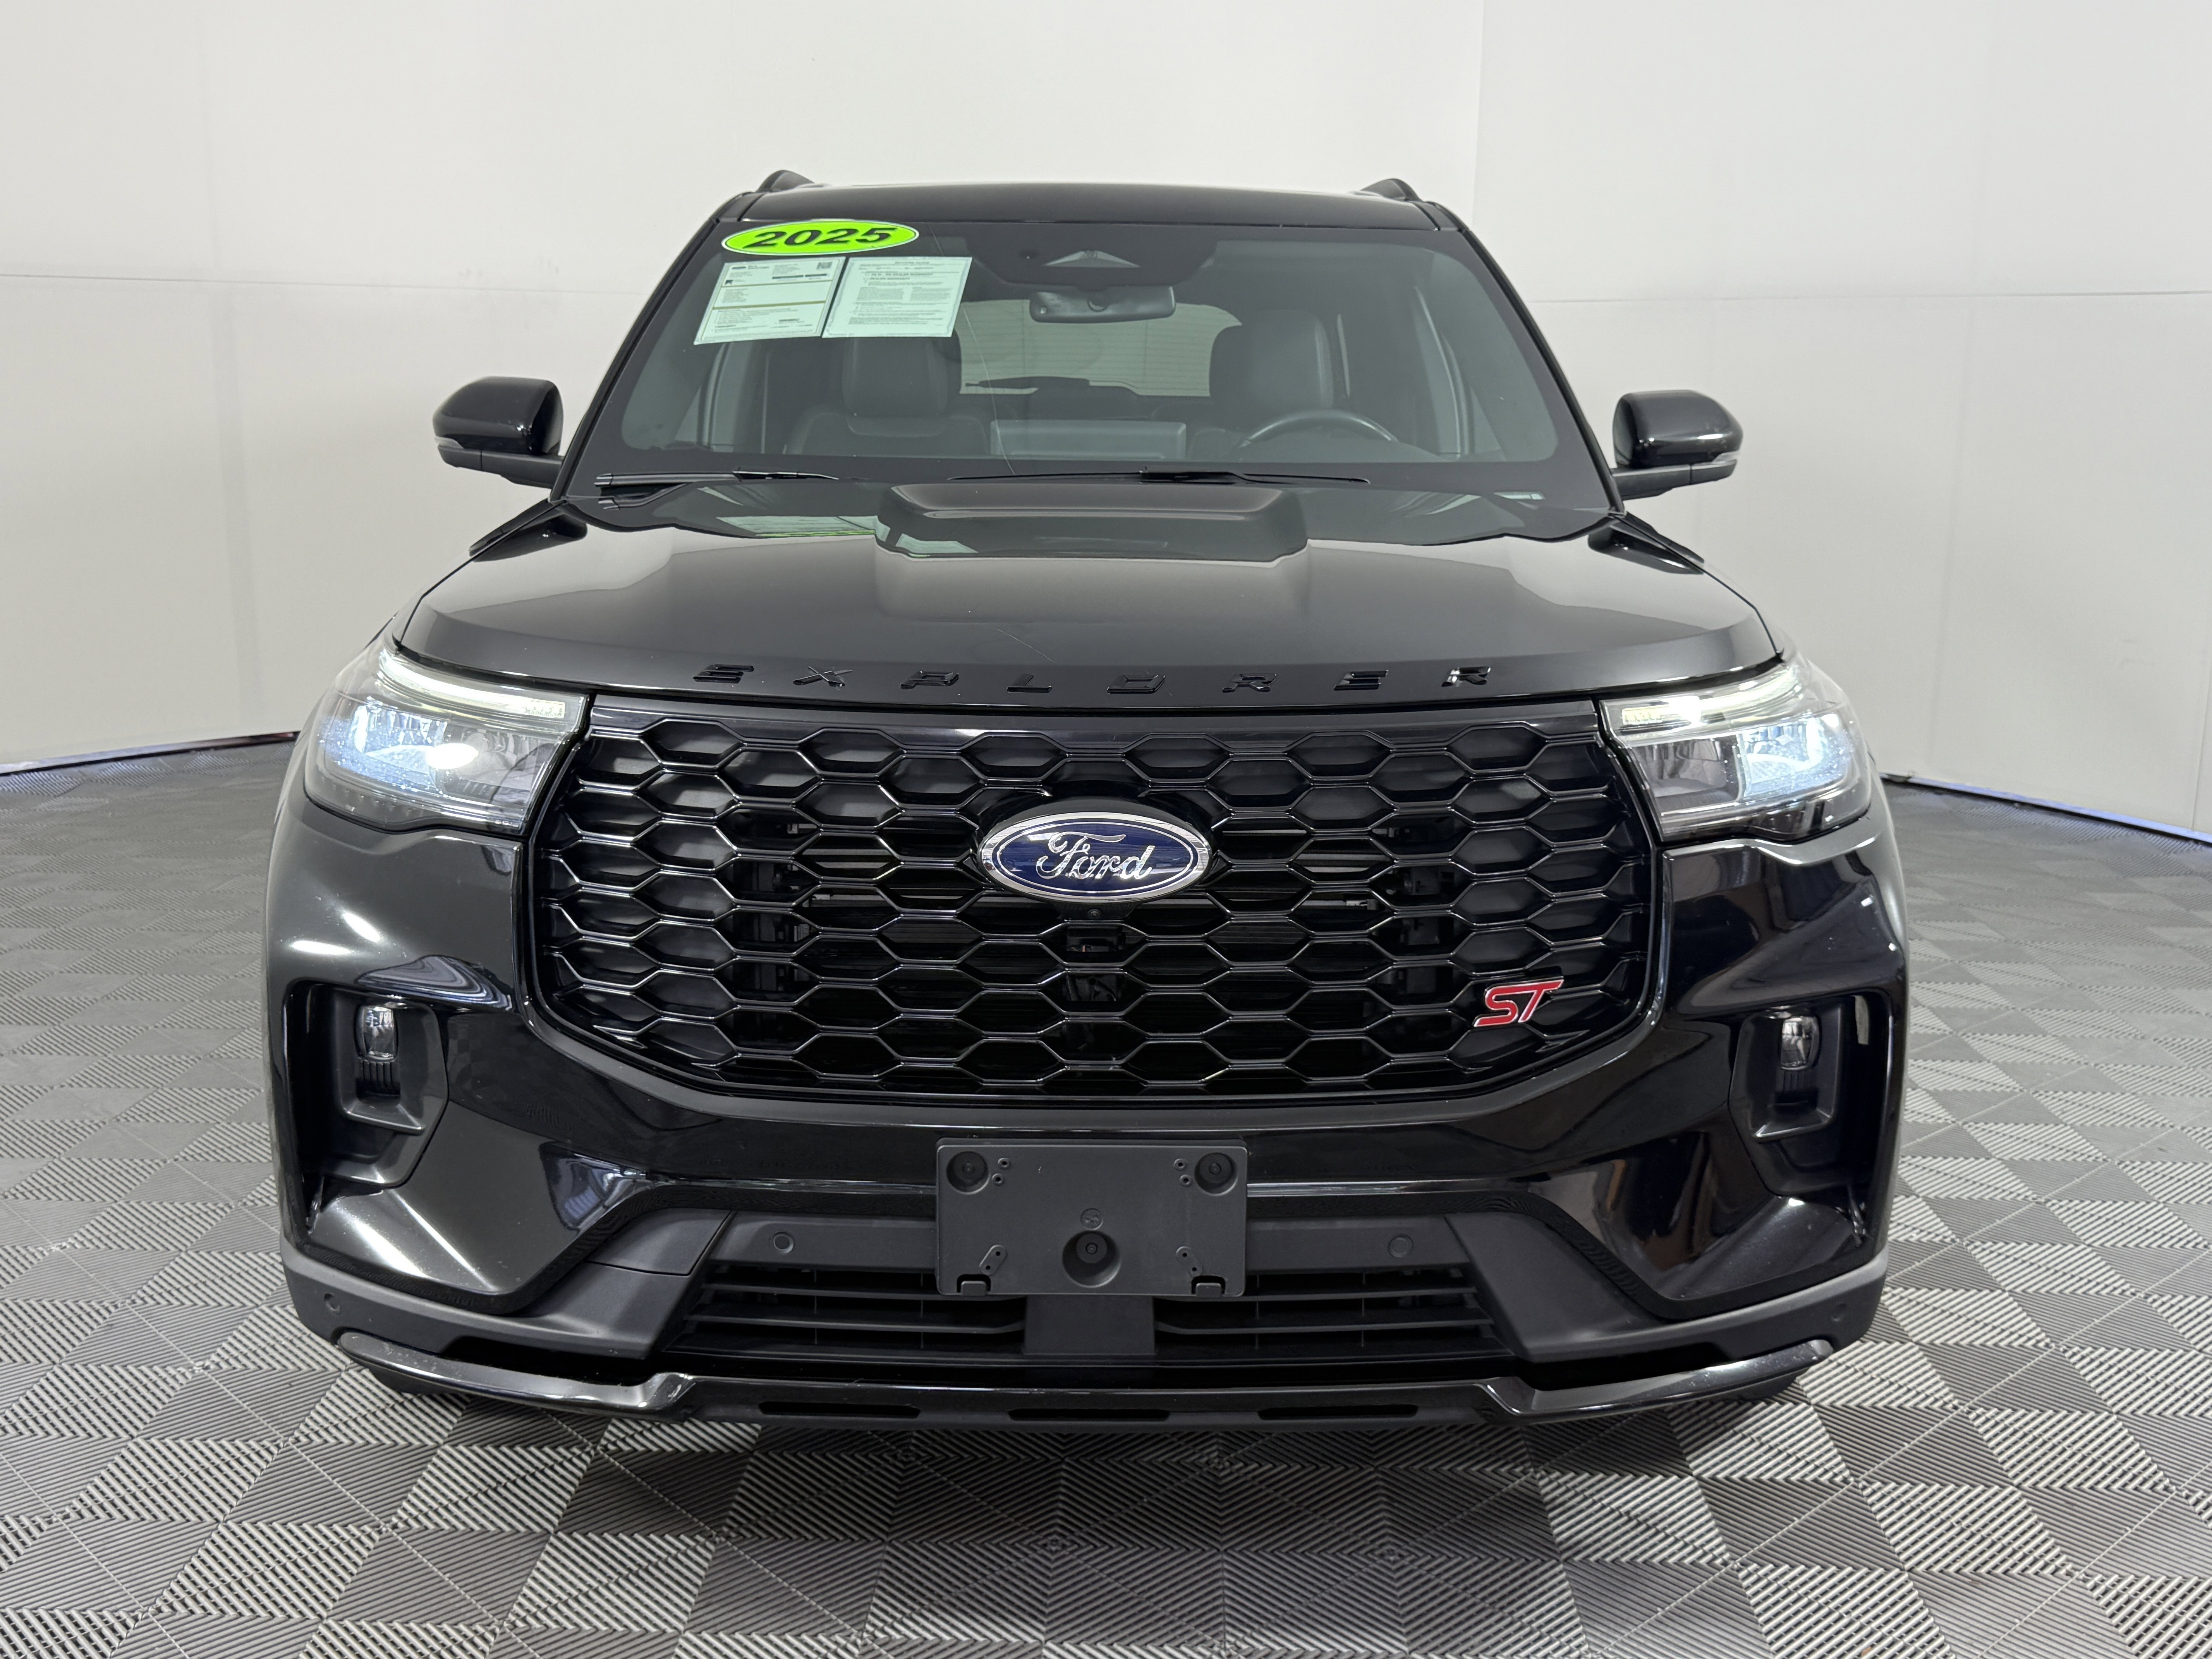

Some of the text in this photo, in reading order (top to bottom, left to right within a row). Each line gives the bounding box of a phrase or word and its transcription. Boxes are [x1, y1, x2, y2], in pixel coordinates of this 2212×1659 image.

[742, 227, 898, 249] 2025
[692, 664, 1491, 694] EXPLORER
[1036, 831, 1156, 879] Ford
[1474, 979, 1564, 1027] ST
